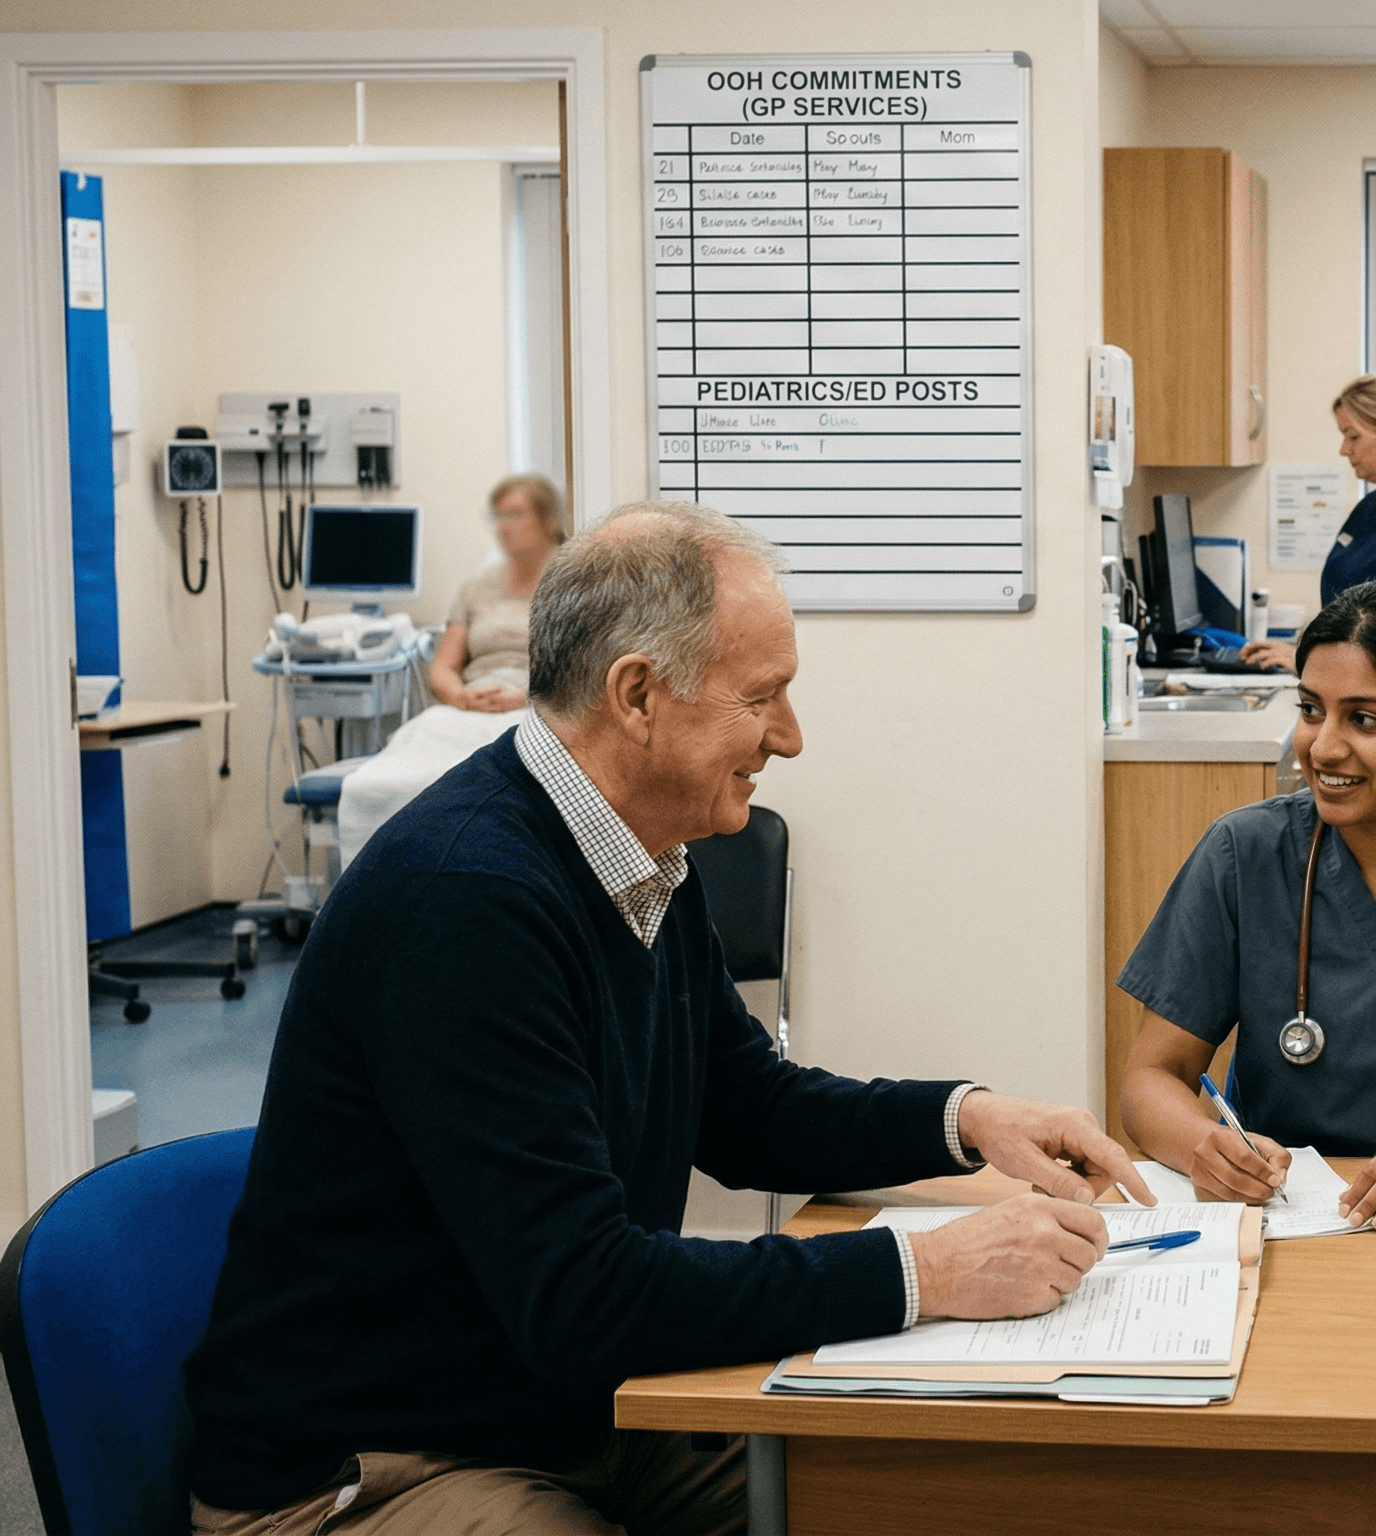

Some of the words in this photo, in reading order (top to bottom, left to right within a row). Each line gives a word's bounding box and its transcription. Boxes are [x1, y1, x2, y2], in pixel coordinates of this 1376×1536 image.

[707, 71, 763, 91] OOH
[771, 69, 962, 91] COMMITMENTS
[742, 97, 786, 121] (GP
[793, 96, 928, 121] SERVICES)
[730, 131, 764, 145] Date
[940, 130, 975, 144] Mom
[659, 159, 674, 175] 21
[697, 380, 887, 402] PEDIATRICS/ED
[895, 380, 979, 401] POSTS
